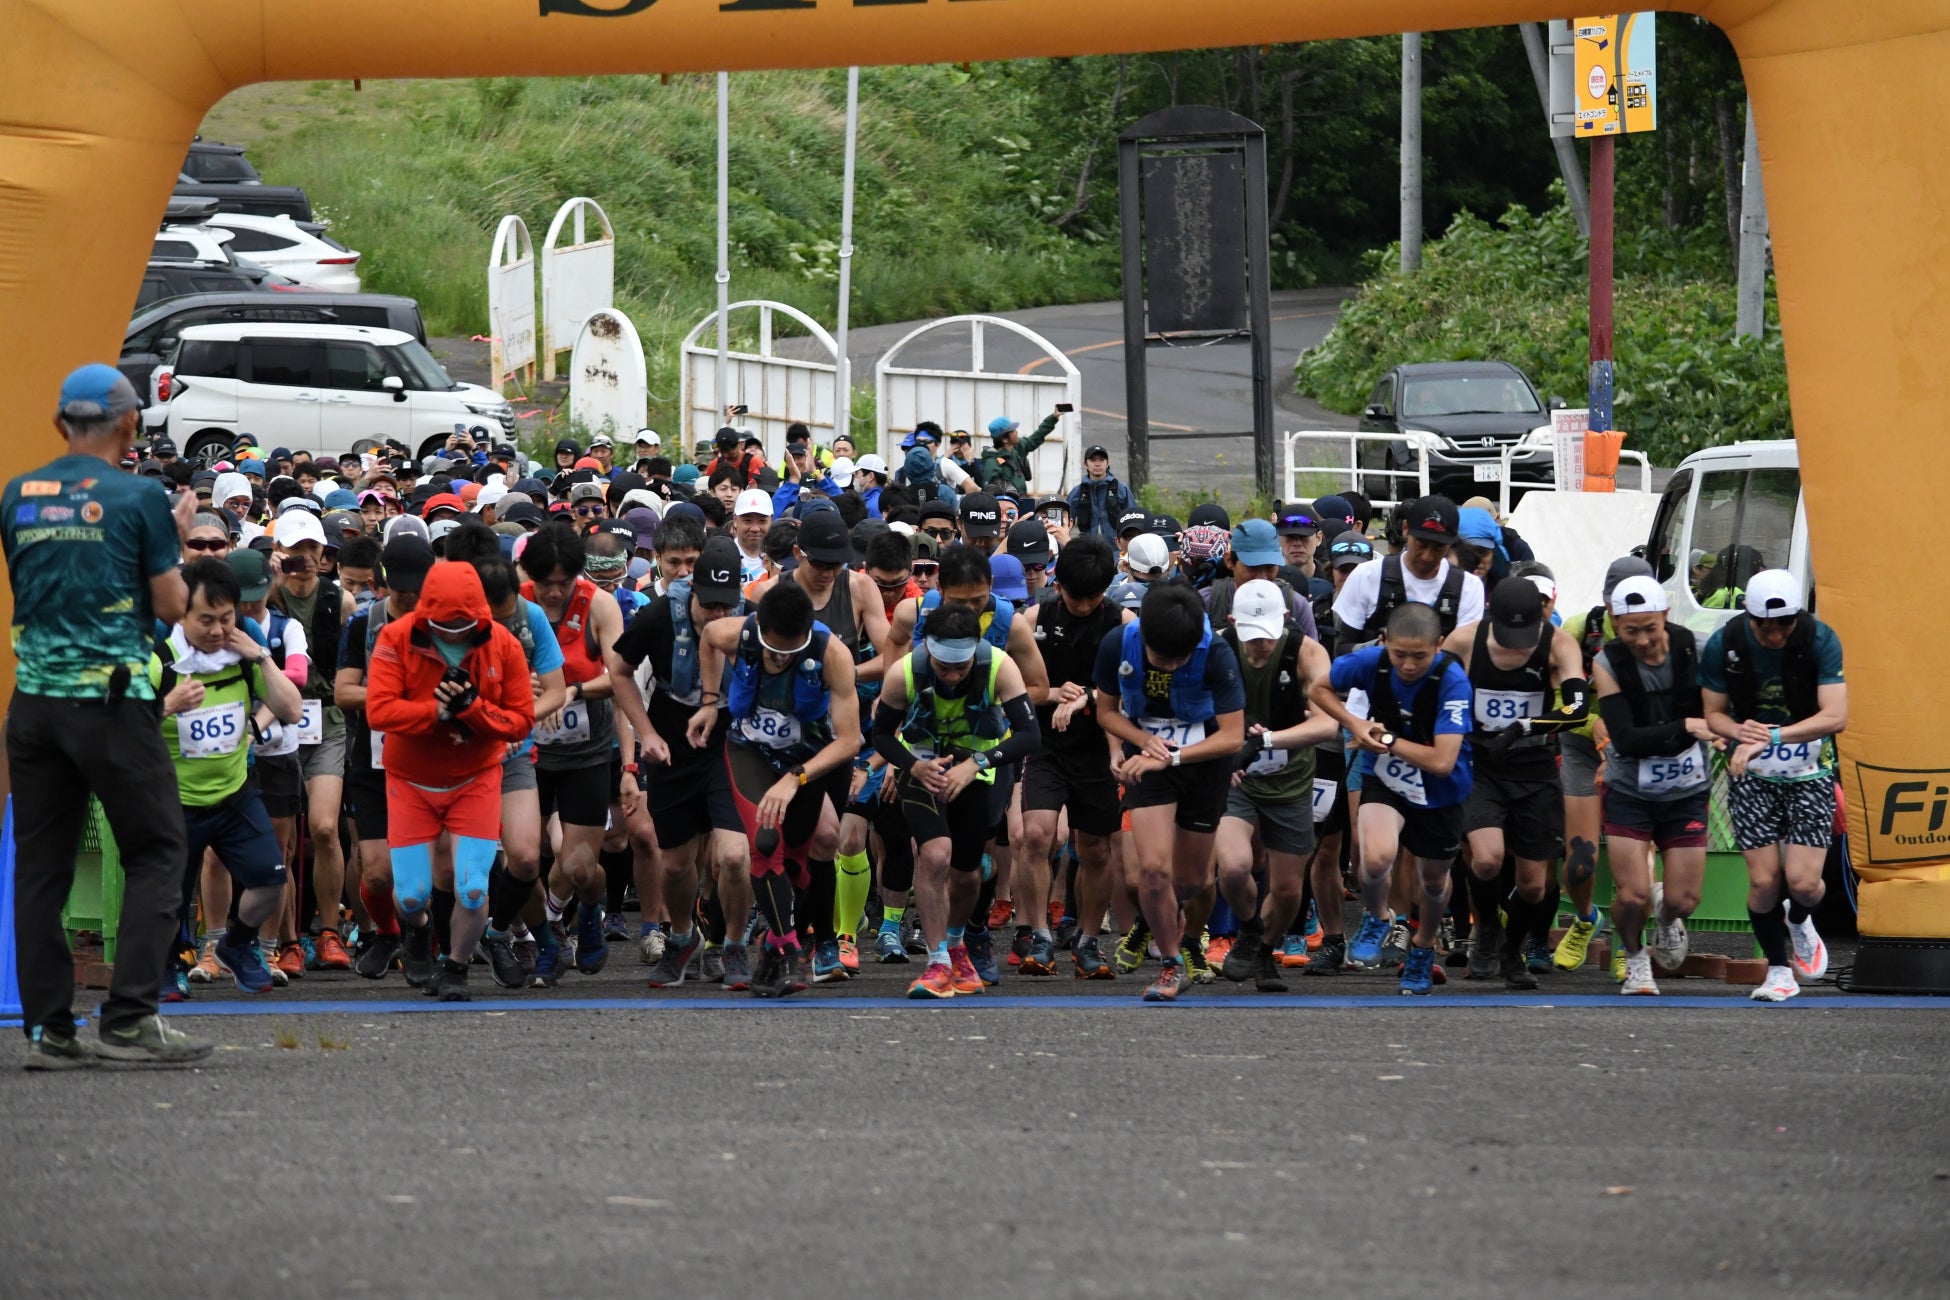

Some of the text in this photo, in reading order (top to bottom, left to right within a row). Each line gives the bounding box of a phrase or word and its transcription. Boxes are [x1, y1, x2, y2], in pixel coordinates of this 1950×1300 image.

[969, 511, 997, 520] PING
[1119, 512, 1146, 524] adidas
[610, 527, 633, 538] JAPAN
[1486, 698, 1530, 719] 831
[190, 713, 236, 742] 865
[750, 713, 792, 738] 886
[1386, 758, 1424, 789] 62
[1650, 756, 1695, 784] 558
[1895, 833, 1950, 845] Outdo
